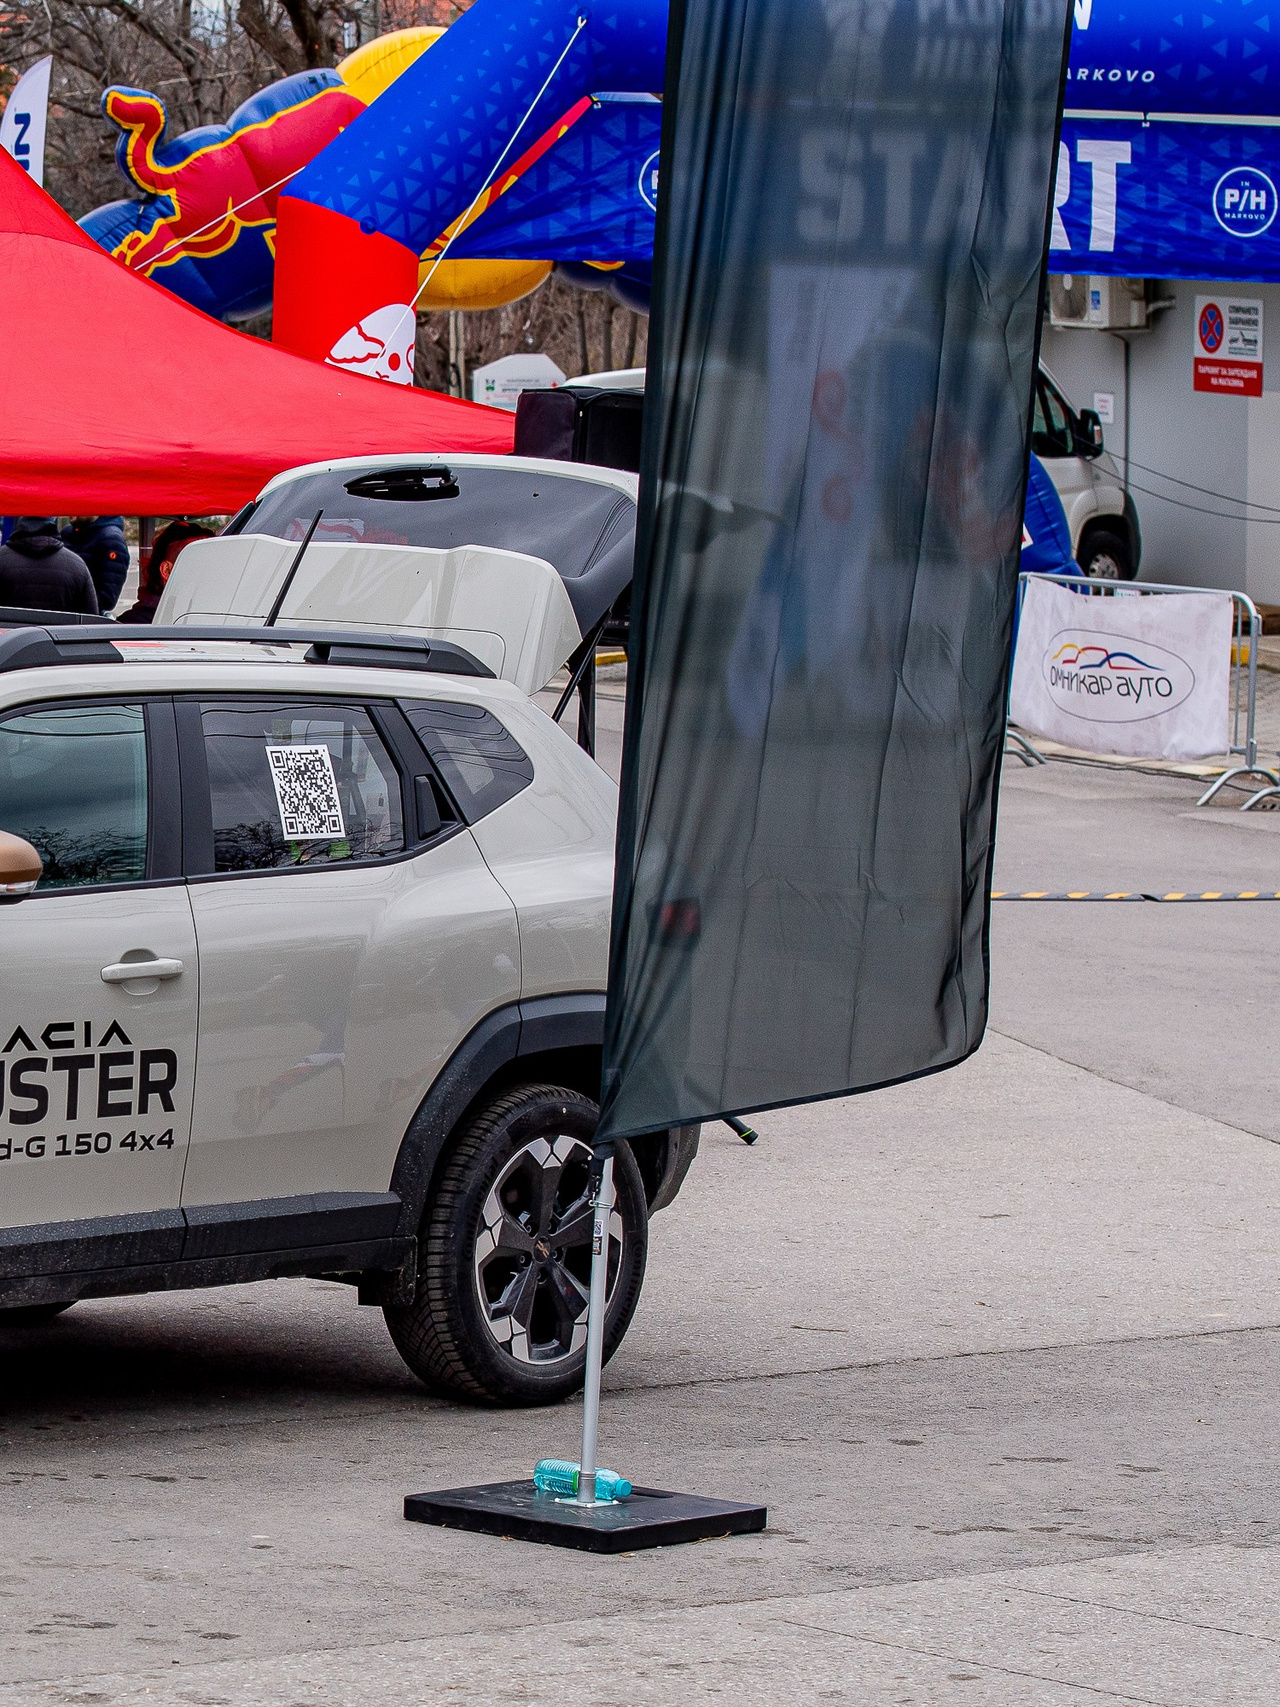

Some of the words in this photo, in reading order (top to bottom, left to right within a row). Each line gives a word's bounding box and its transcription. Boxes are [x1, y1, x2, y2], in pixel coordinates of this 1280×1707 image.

[1066, 66, 1156, 83] RKOVO
[1225, 188, 1267, 212] P/H
[1224, 212, 1266, 220] MARKOVO
[55, 1131, 112, 1157] 150
[119, 1128, 175, 1152] 4x4
